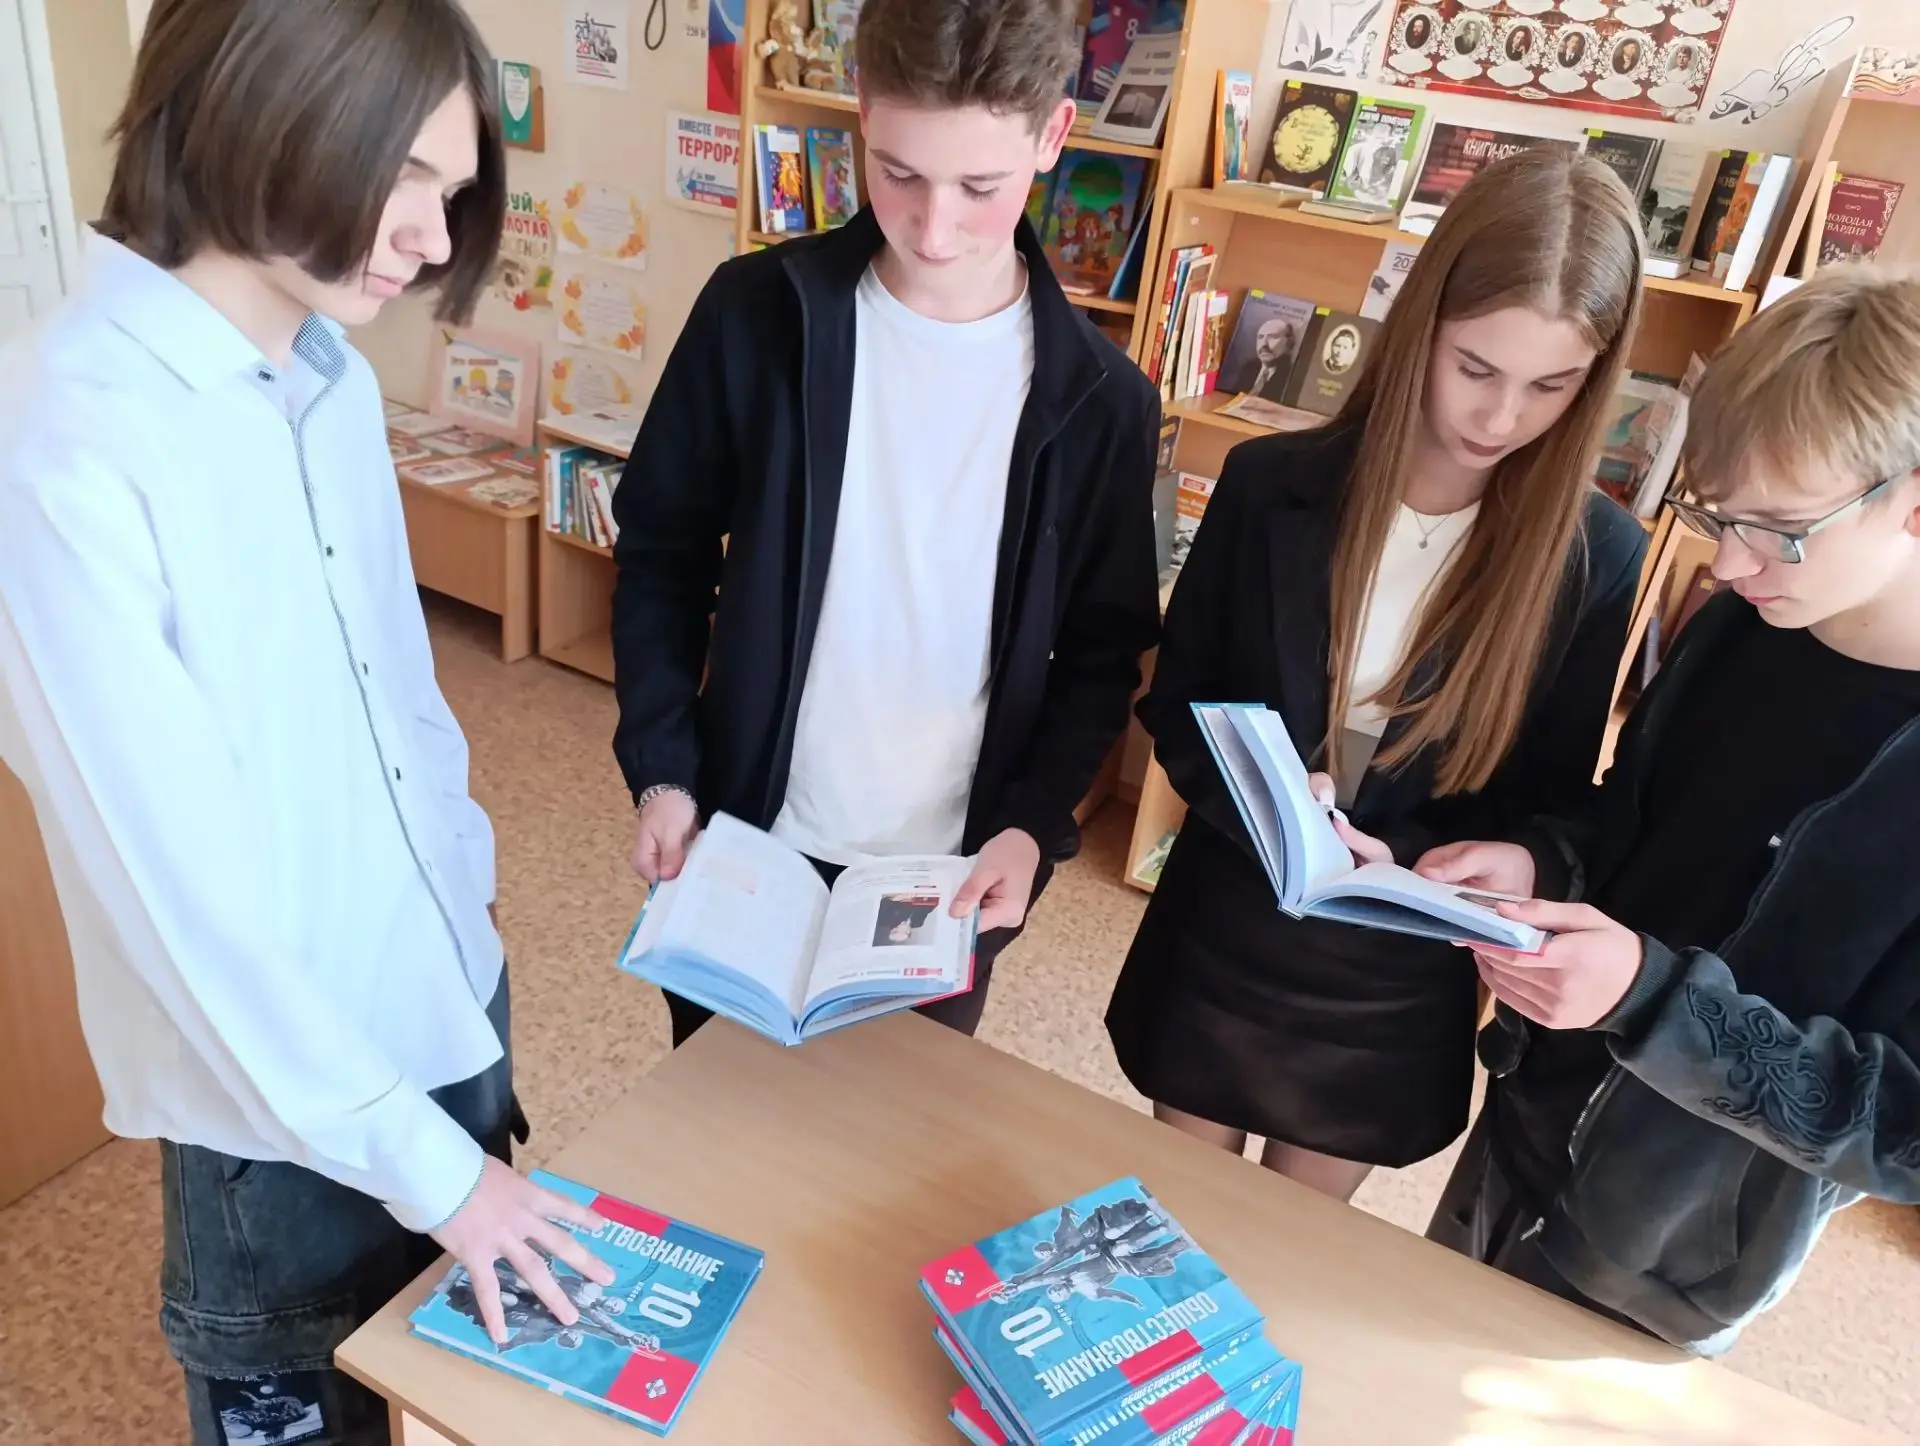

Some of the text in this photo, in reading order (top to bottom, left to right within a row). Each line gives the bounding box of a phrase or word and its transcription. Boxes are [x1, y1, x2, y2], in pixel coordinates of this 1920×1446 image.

[1125, 18, 1138, 40] 8
[678, 118, 711, 137] ВМЕСТЕ
[1462, 139, 1529, 160] КНИГИ-ЮБ
[505, 216, 548, 239] ЛОТАЯ
[547, 1217, 725, 1282] СТВОЗНАНИЕ
[638, 1282, 701, 1328] 10
[1000, 1306, 1063, 1358] 10
[1034, 1291, 1219, 1399] ОБЩЕСТВОЗНАНИЕ
[1121, 1356, 1203, 1405] ОБЩЕСТВОЗНАНИЕ
[1153, 1400, 1226, 1446] ЩЕСТВОЗНАНИЕ
